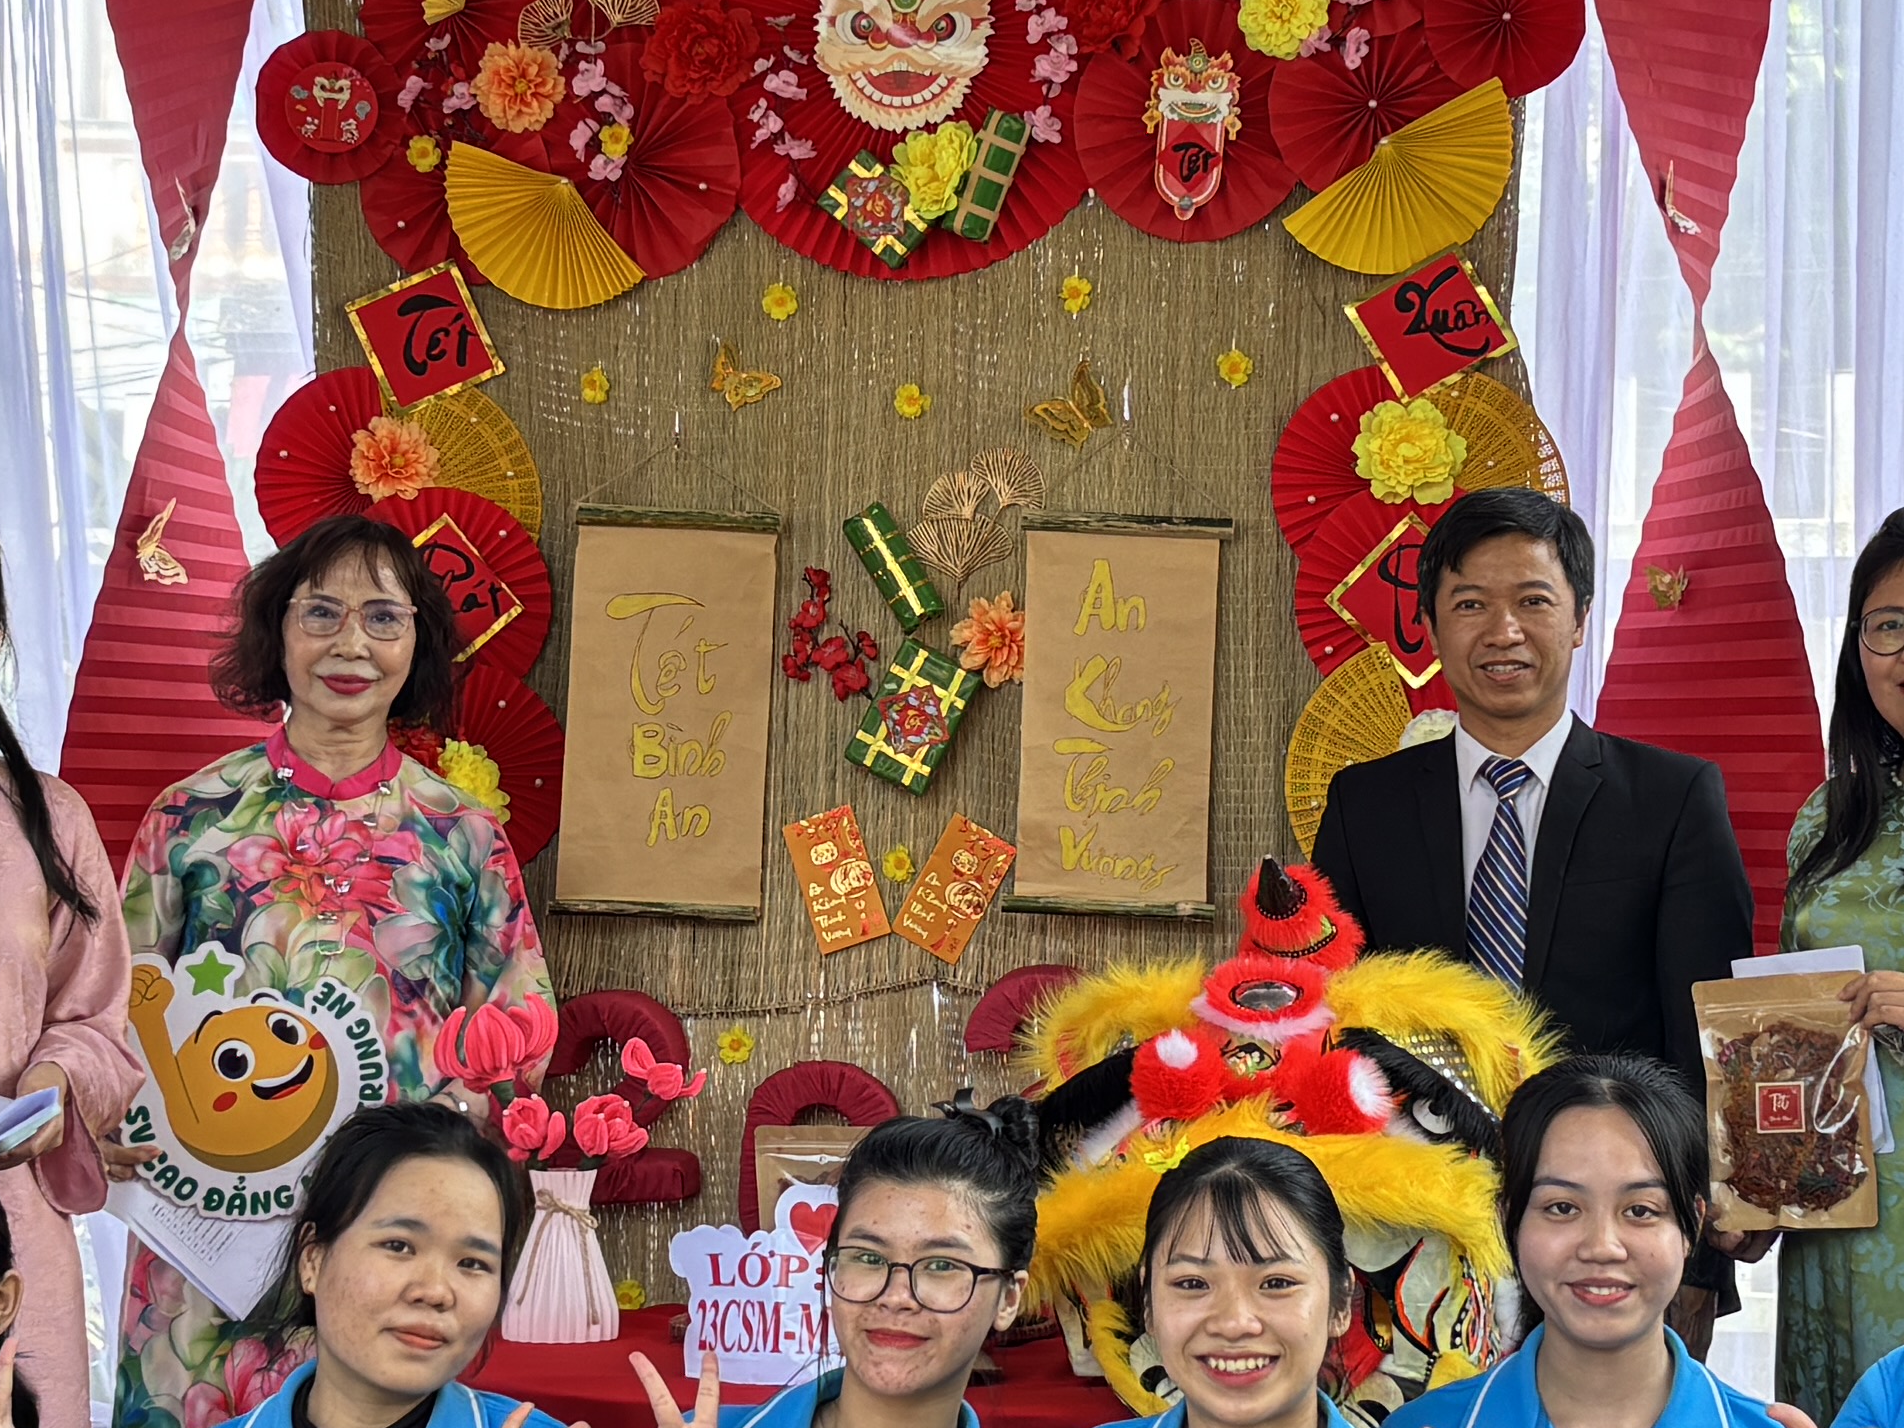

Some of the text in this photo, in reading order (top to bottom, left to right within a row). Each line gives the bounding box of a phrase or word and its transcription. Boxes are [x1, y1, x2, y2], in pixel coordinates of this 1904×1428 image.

[397, 294, 478, 376] Tết
[1073, 558, 1147, 636] An
[605, 592, 728, 715] Tết
[1064, 653, 1182, 738] Khang
[628, 710, 733, 779] Bình
[646, 786, 712, 848] An
[125, 1105, 156, 1143] SV
[202, 1176, 294, 1216] ĐẲNG
[311, 982, 355, 1020] NÈ
